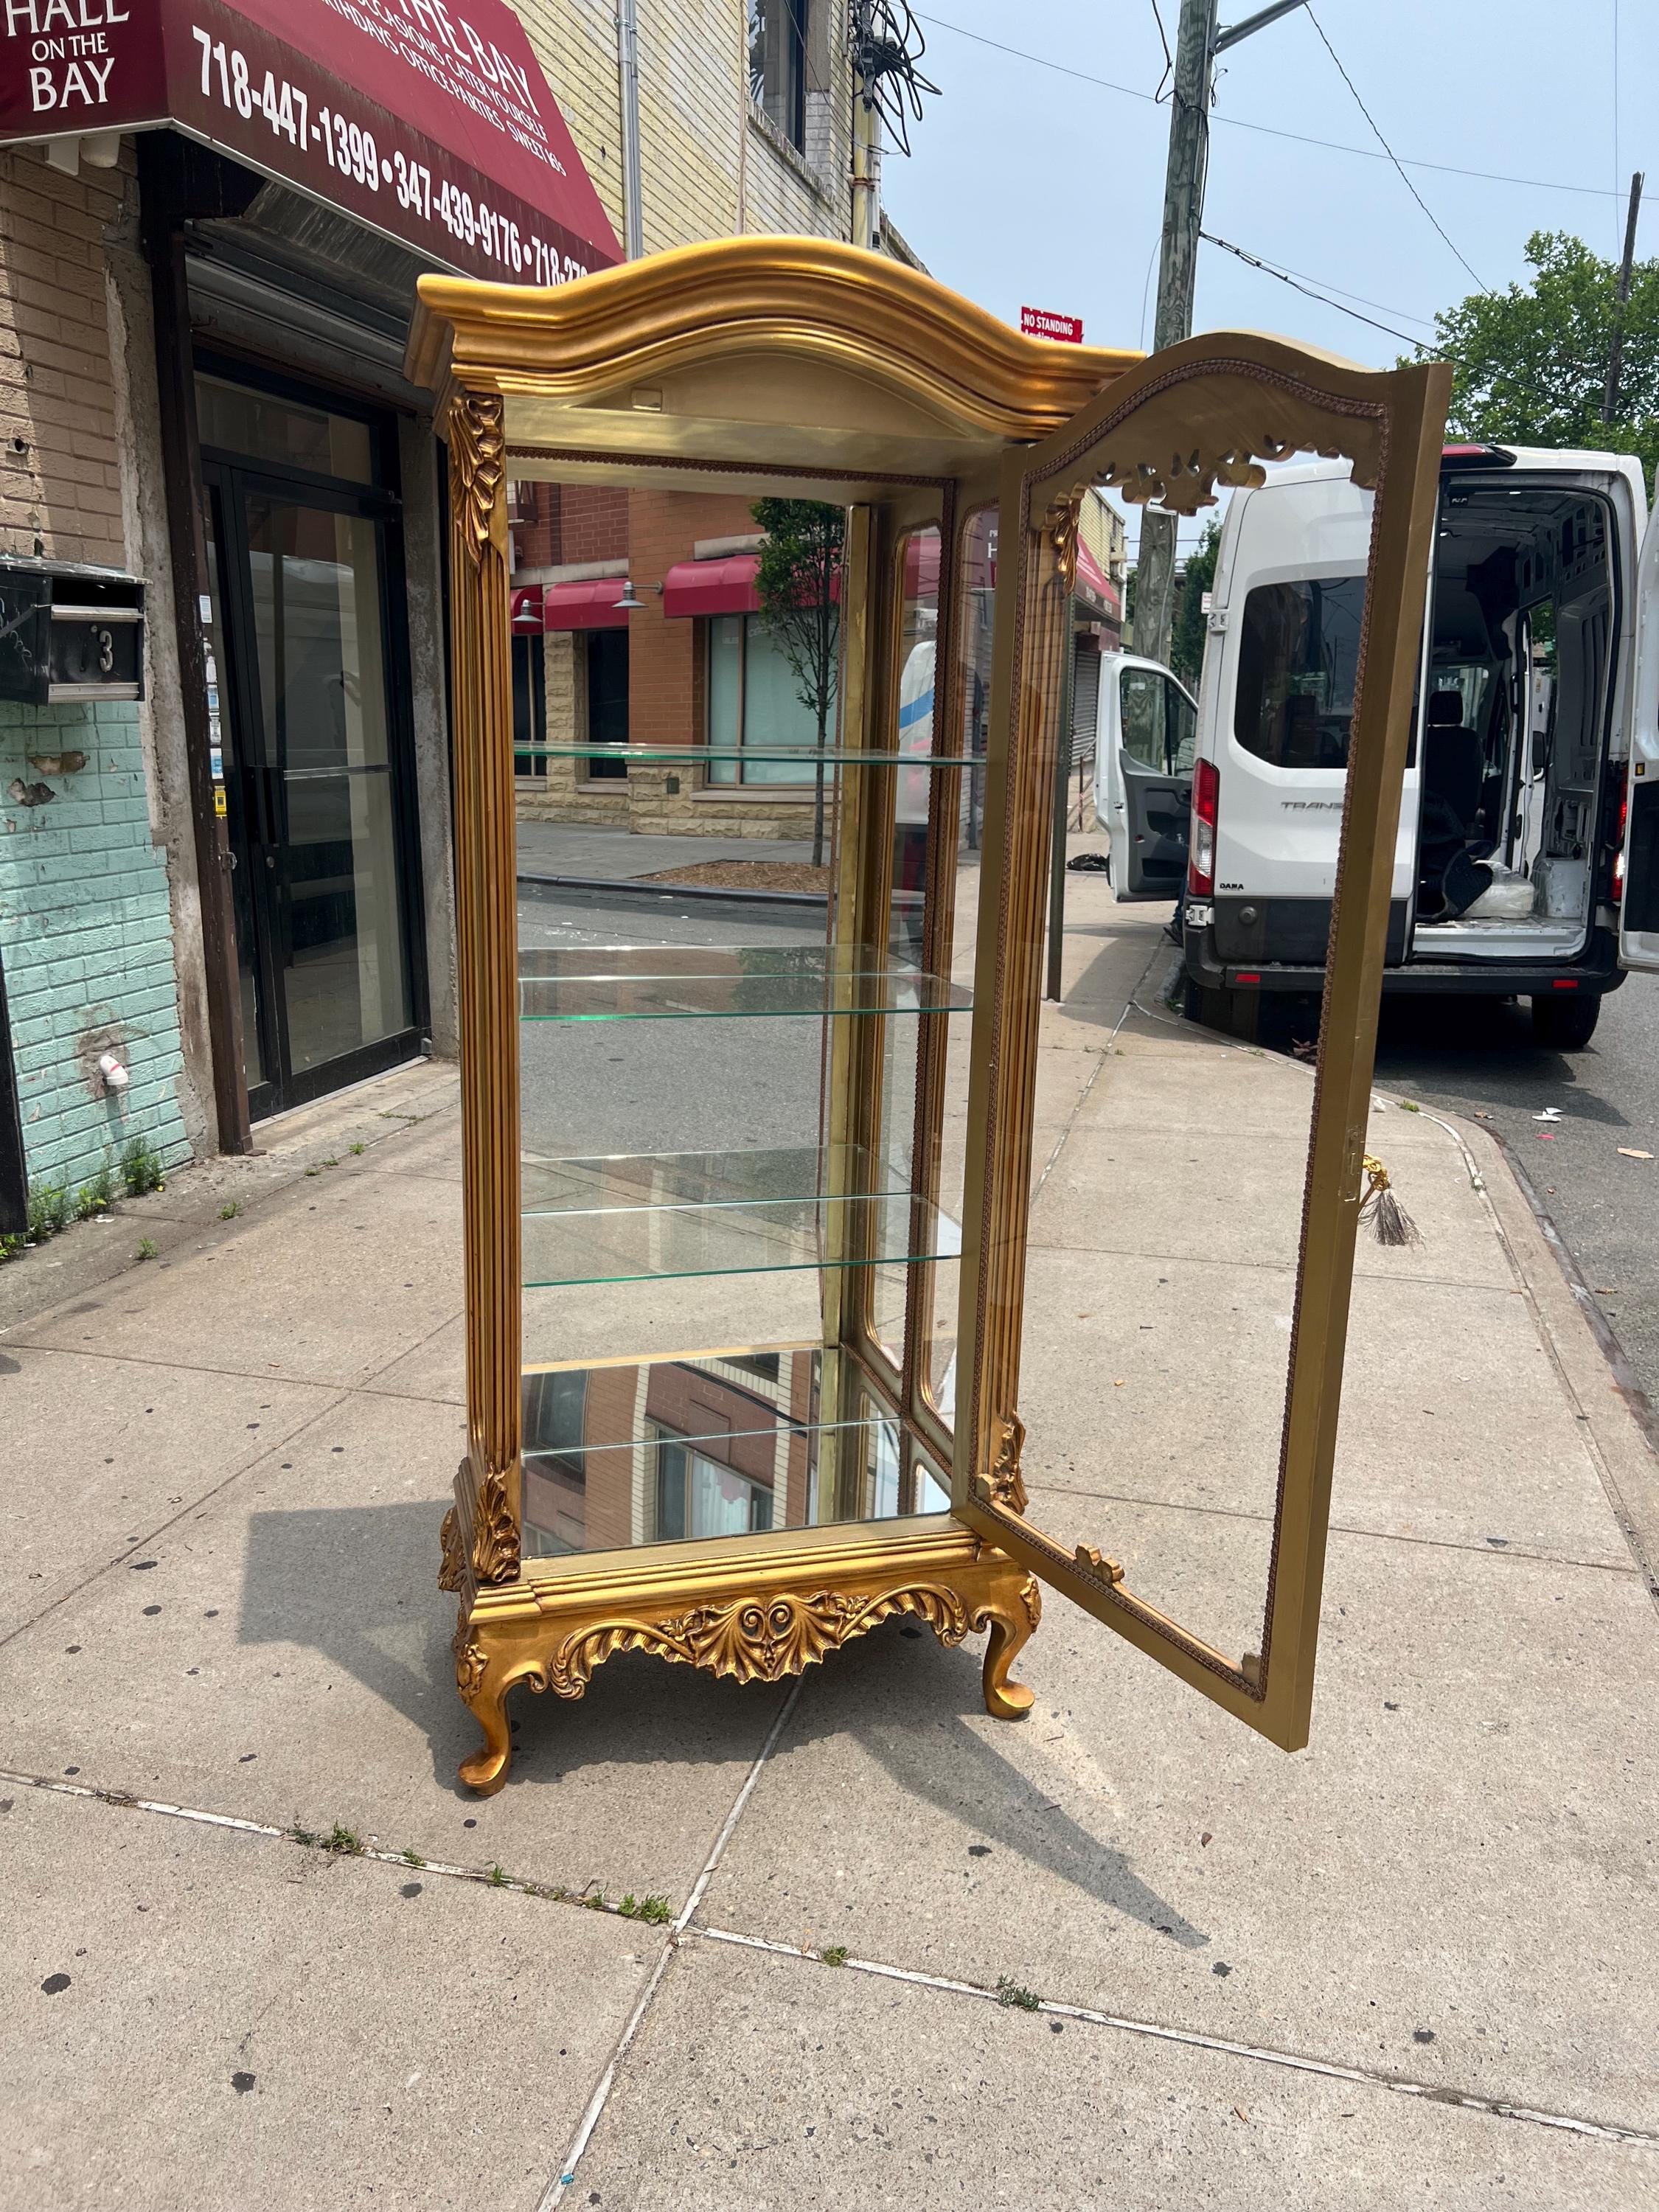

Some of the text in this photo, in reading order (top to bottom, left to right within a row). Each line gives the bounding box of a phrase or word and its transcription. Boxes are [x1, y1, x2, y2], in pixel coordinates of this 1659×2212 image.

[5, 0, 129, 37] HALL
[32, 32, 108, 62] ON THE
[358, 0, 549, 144] CCASIONS CATER YOURSELF
[457, 16, 540, 117] BAY
[29, 58, 115, 112] BAY
[400, 41, 455, 95] OFFICE
[448, 77, 505, 132] PARTIES
[506, 120, 549, 164] SWEET
[192, 24, 379, 192] 718-447-1399
[394, 150, 521, 273] 347-439-9176
[1023, 313, 1073, 335] NO STANDING
[99, 630, 114, 672] 3
